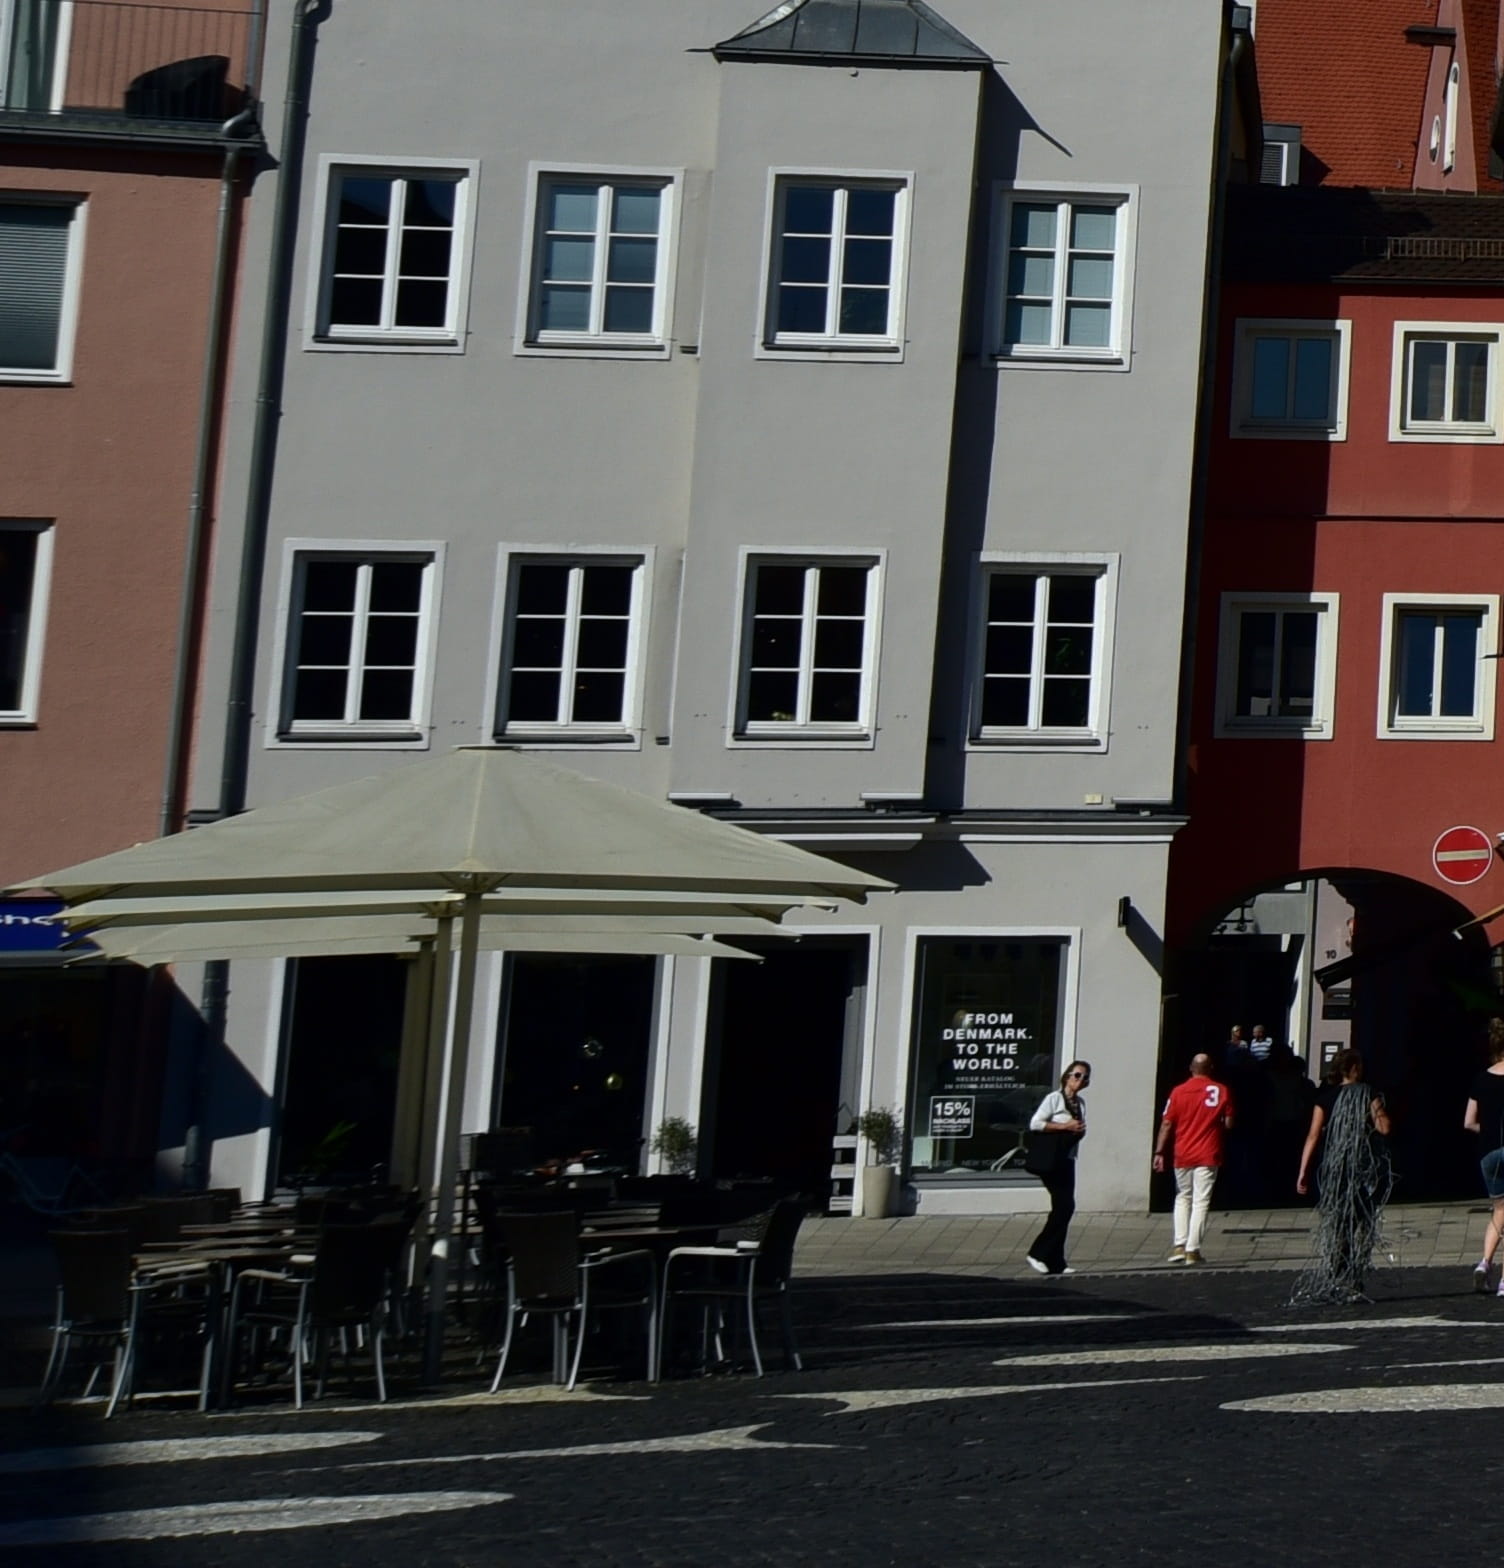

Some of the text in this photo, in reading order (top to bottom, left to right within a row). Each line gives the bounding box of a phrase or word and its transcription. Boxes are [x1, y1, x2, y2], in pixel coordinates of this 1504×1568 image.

[1325, 950, 1337, 959] 10
[965, 1012, 1014, 1025] FROM
[942, 1028, 1033, 1040] DENMARK.
[955, 1043, 1019, 1055] TO THE
[952, 1058, 1020, 1070] WORLD.
[1204, 1084, 1220, 1108] 3
[934, 1101, 971, 1116] 15%
